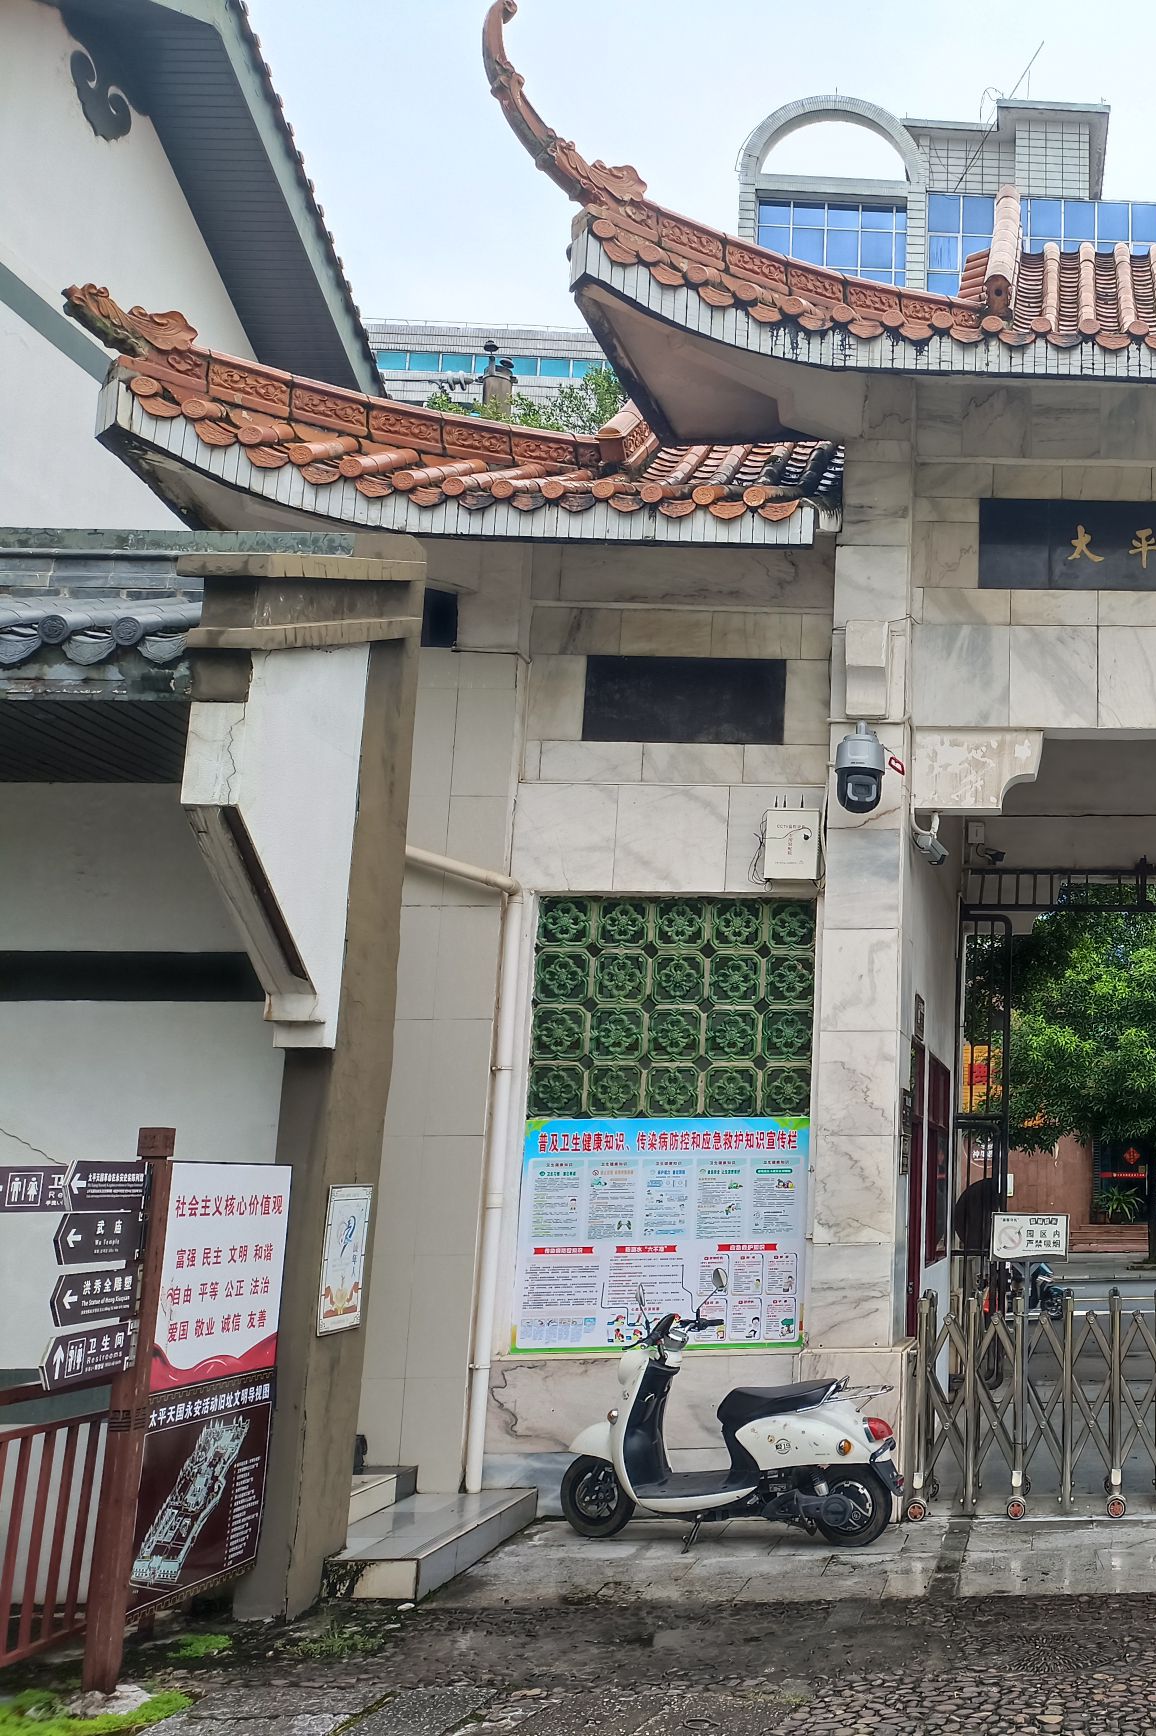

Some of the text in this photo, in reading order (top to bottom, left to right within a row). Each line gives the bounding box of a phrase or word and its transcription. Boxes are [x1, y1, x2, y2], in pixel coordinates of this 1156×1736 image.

[175, 1194, 284, 1219] 社会主义核心价值观
[96, 1219, 122, 1235] 武庙
[1026, 1239, 1060, 1249] 严禁吸烟
[176, 1242, 274, 1270] 富强 民主 文明 和谐
[82, 1275, 133, 1295] 洪秀全雕塑
[171, 1275, 270, 1307] 自由 平等 公正 法治
[167, 1309, 267, 1343] 爱国 敬业 诚信 友善
[87, 1331, 125, 1354] 卫生间
[86, 1351, 123, 1364] Restrooms
